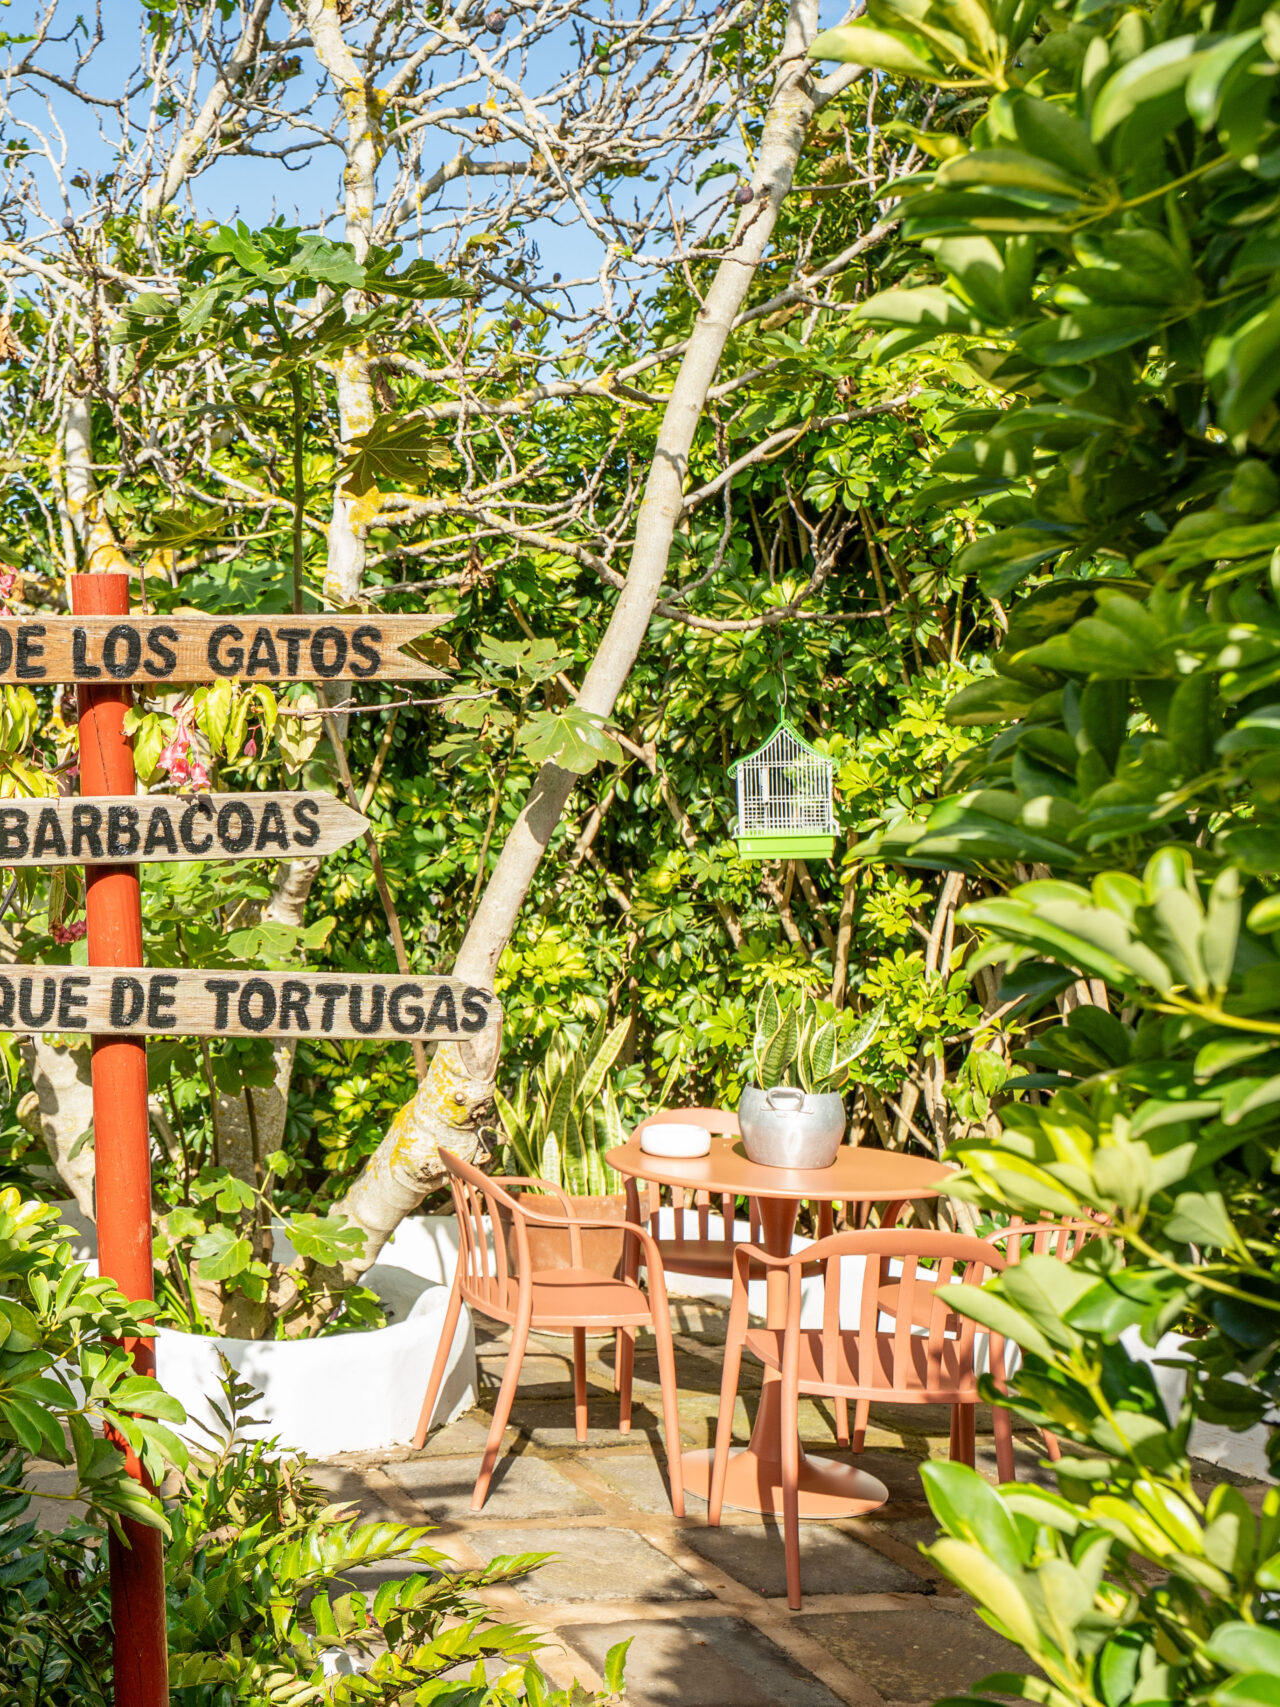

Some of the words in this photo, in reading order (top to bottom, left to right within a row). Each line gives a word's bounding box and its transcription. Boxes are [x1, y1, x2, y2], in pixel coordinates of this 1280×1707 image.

[72, 624, 178, 679] LOS
[207, 624, 382, 678] GATOS
[110, 974, 179, 1029] DE
[204, 977, 493, 1034] TORTUGAS
